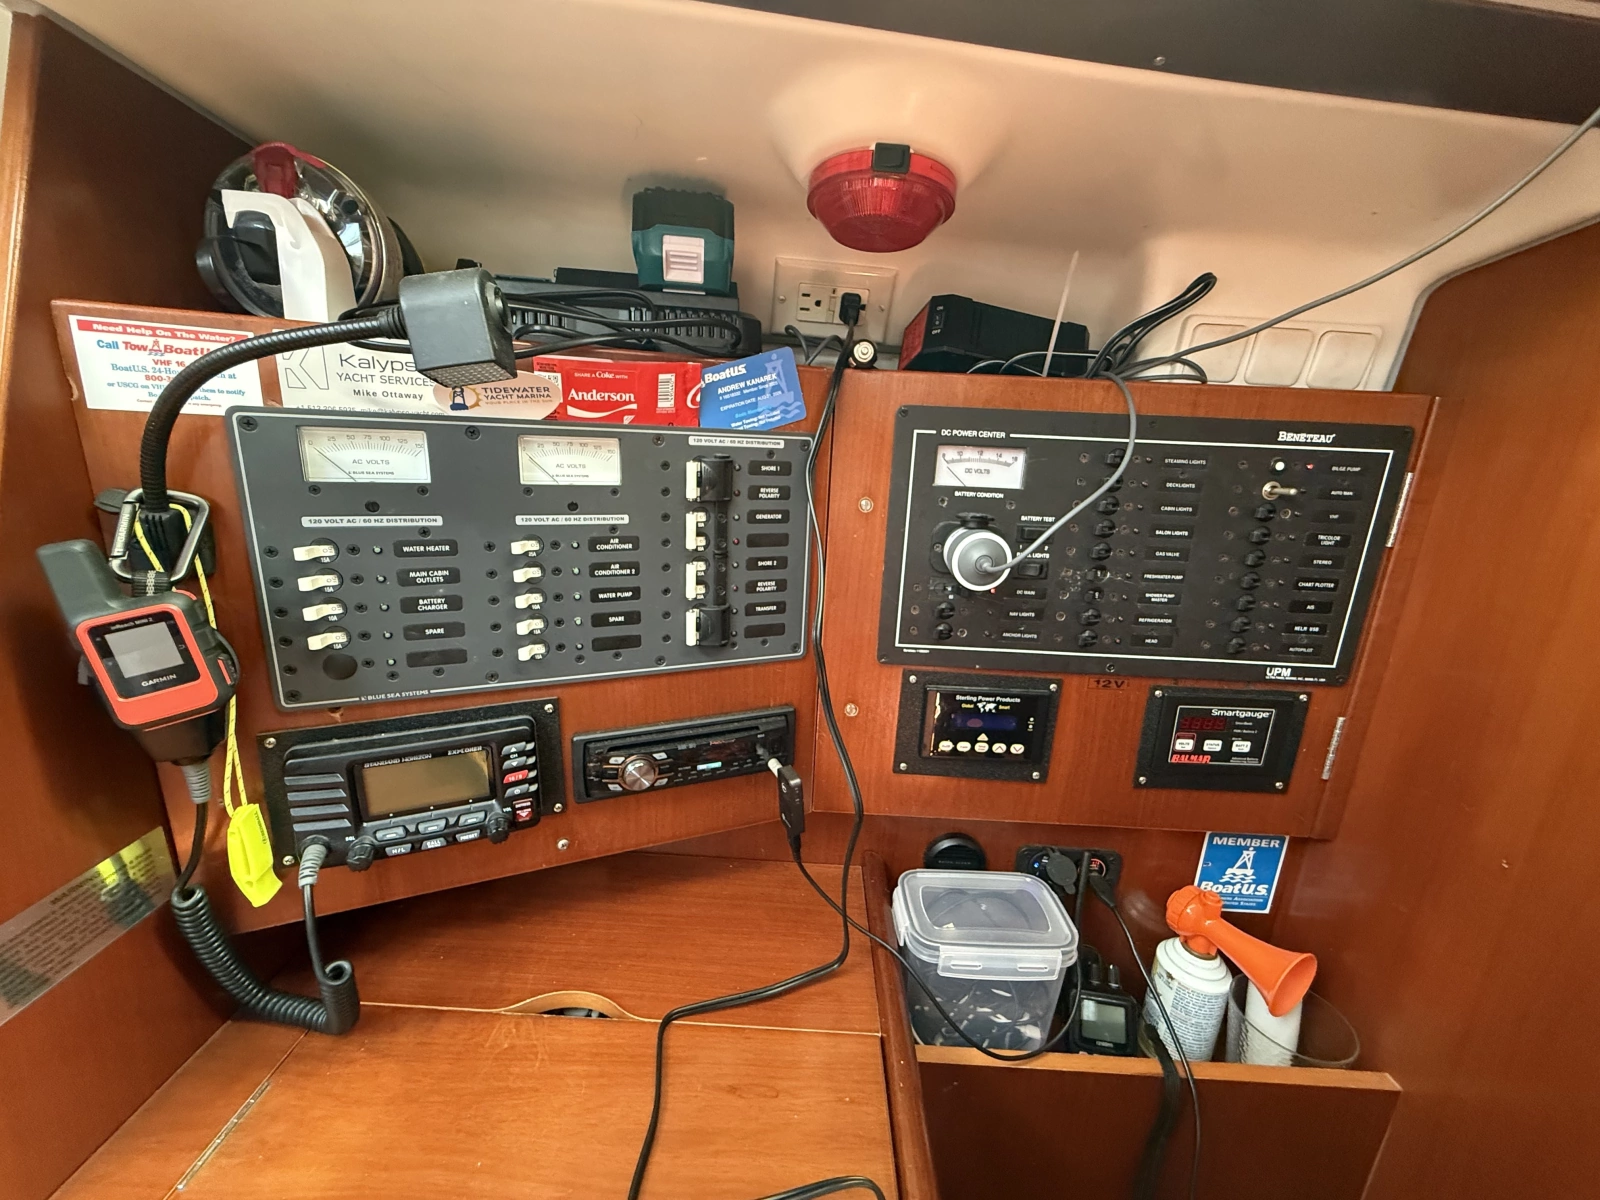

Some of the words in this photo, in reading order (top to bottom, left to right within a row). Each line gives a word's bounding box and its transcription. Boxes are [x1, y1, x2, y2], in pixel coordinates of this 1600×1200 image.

[92, 323, 123, 332] Need
[126, 326, 153, 336] Help
[198, 333, 236, 342] Water?
[96, 339, 120, 350] Call
[336, 372, 376, 384] YACHT
[596, 370, 614, 379] Coke
[718, 380, 746, 394] ANDREW
[746, 372, 778, 387] KANAREK
[226, 389, 246, 397] notify
[353, 389, 378, 397] Mike
[382, 390, 424, 401] Ottaway
[481, 386, 550, 394] TIDEWATER
[568, 388, 636, 402] Anderson
[720, 401, 745, 412] EXPIRATION
[952, 430, 978, 438] POWER
[1277, 430, 1336, 444] BENETEAU
[426, 544, 450, 552] HEATER
[409, 570, 428, 578] MAIN
[594, 568, 631, 576] CONDITIONER
[416, 576, 444, 584] OUTLETS
[1266, 667, 1292, 677] UPM
[141, 673, 178, 687] GARMIN
[1093, 679, 1126, 688] 12V
[402, 689, 429, 697] SYSTEMS
[956, 694, 977, 702] Sterling
[1211, 708, 1270, 718] Smartgauge
[1170, 754, 1211, 764] BALMAR
[1212, 836, 1280, 848] MEMBER
